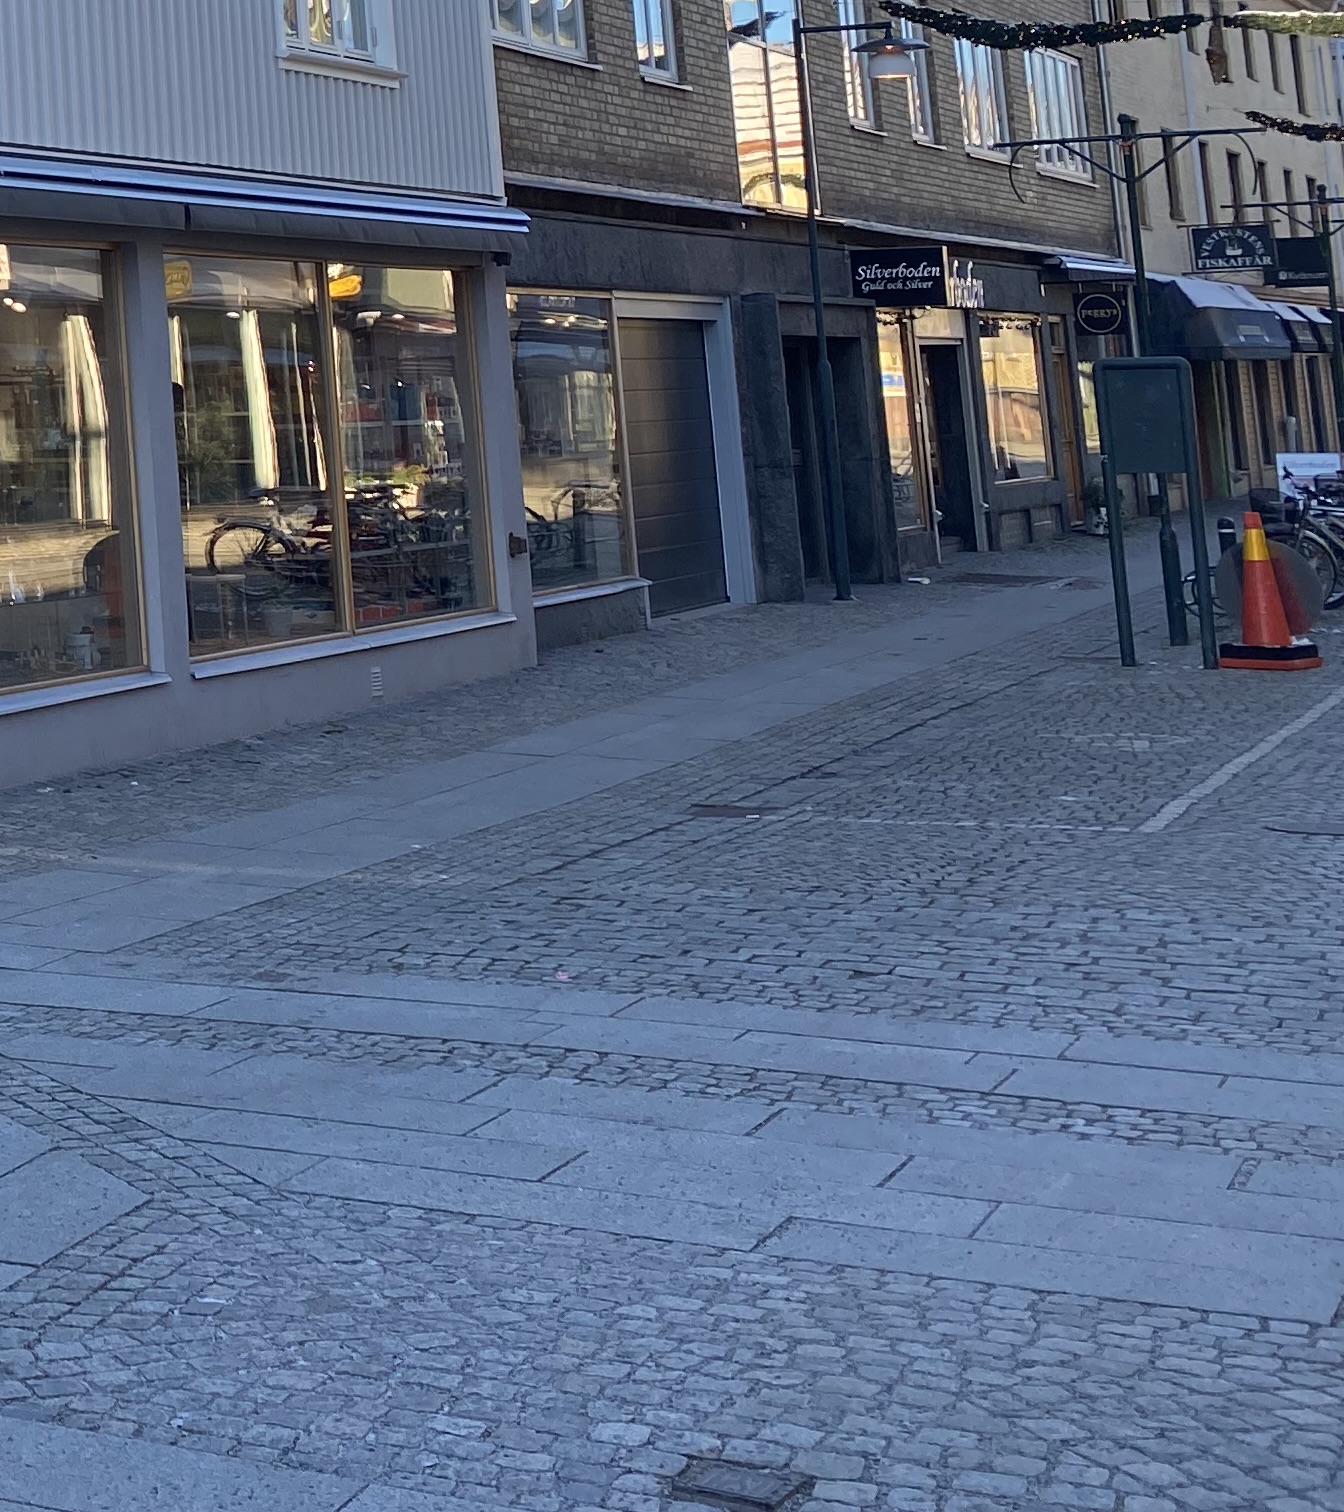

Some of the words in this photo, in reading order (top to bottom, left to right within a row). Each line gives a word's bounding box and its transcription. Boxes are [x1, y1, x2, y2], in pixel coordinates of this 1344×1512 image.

[1200, 229, 1265, 257] VESTKSTENS
[1198, 254, 1273, 269] FISKAFFÄR
[855, 261, 940, 281] Silverboden
[861, 280, 885, 293] Guld
[887, 279, 903, 290] och
[904, 279, 933, 290] Silver
